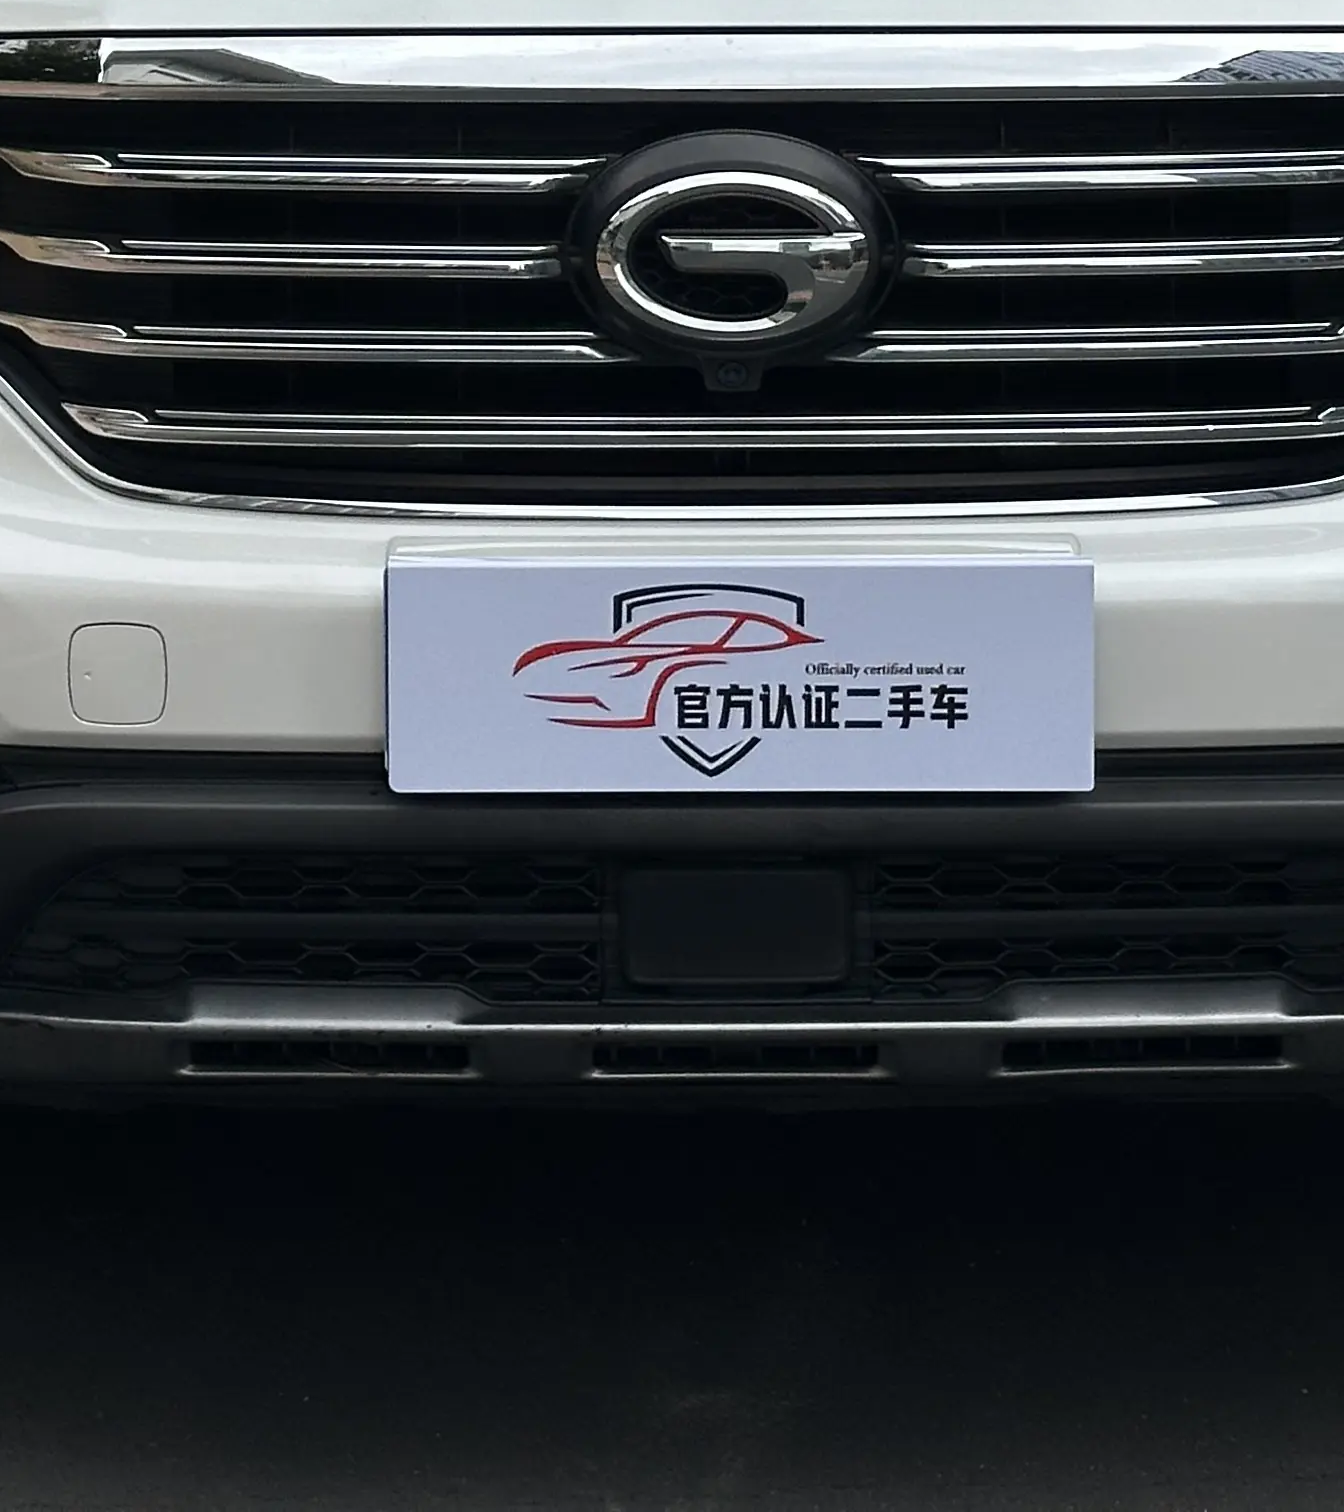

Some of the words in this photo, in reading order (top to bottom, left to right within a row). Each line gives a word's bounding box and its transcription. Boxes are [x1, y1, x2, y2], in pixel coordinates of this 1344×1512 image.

[805, 663, 861, 678] Officially
[863, 663, 913, 676] certified
[916, 663, 944, 676] used
[946, 666, 966, 676] car
[674, 684, 968, 729] 官方认证二手车
